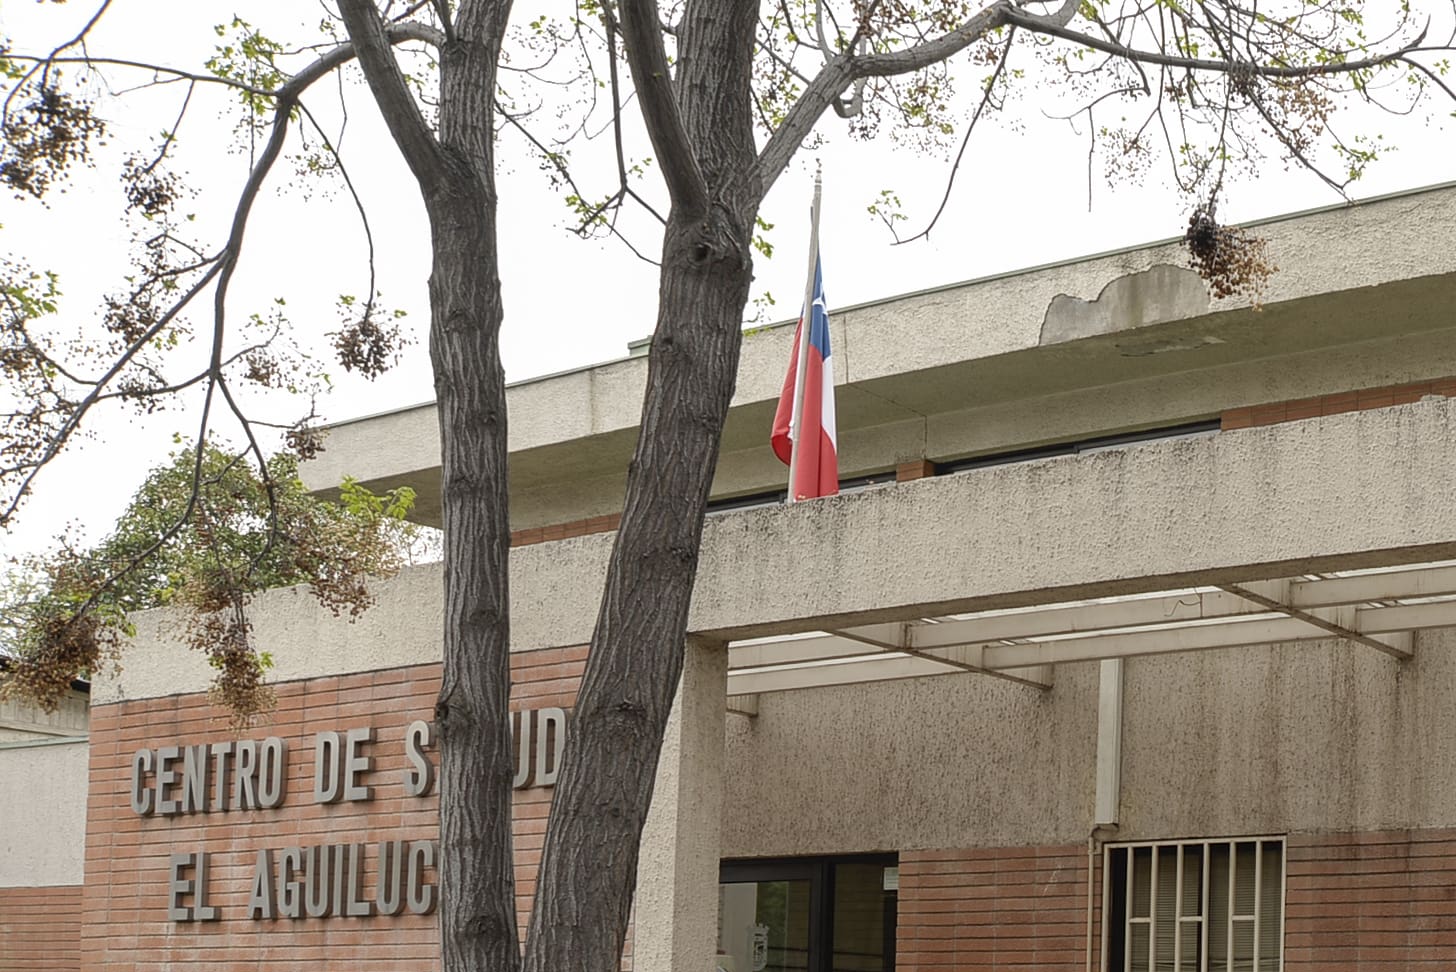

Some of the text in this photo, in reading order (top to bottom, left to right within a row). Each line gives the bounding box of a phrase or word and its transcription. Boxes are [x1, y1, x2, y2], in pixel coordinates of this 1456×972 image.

[131, 707, 567, 815] CENTRO DE SUD
[169, 840, 439, 921] EL AGUILUC
